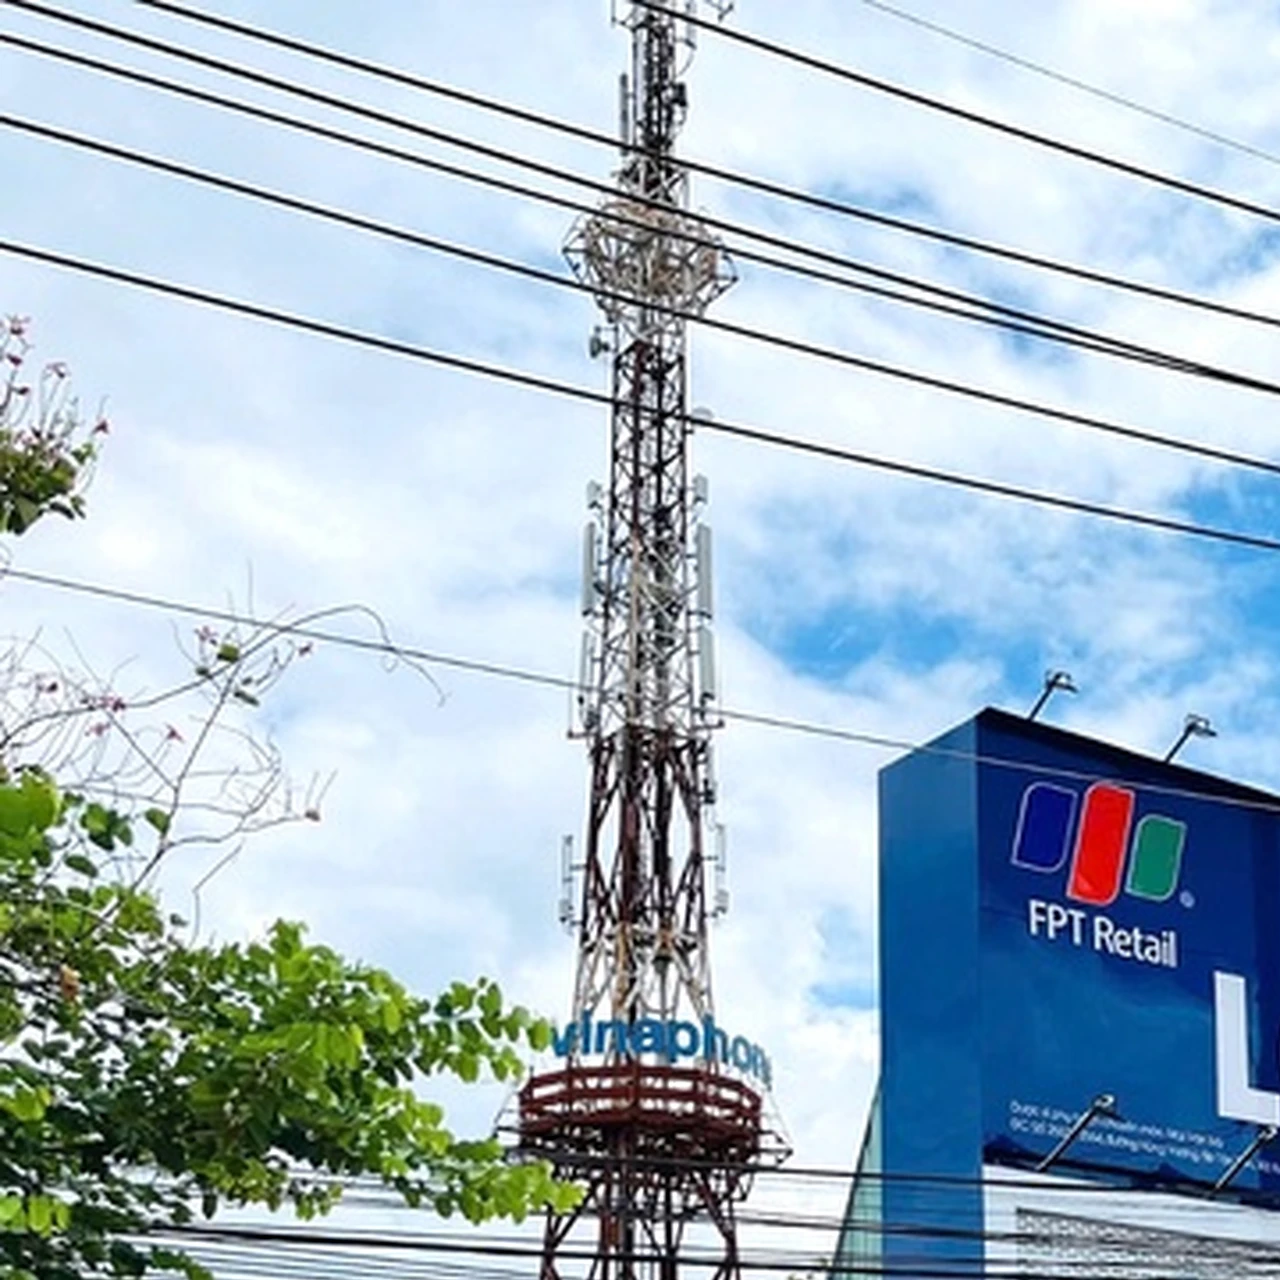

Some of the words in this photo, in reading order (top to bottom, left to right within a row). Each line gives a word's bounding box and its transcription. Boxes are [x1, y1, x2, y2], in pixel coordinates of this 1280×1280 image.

[1029, 899, 1086, 945] FPT
[1093, 915, 1178, 968] Retail
[550, 1009, 772, 1092] vinaphon
